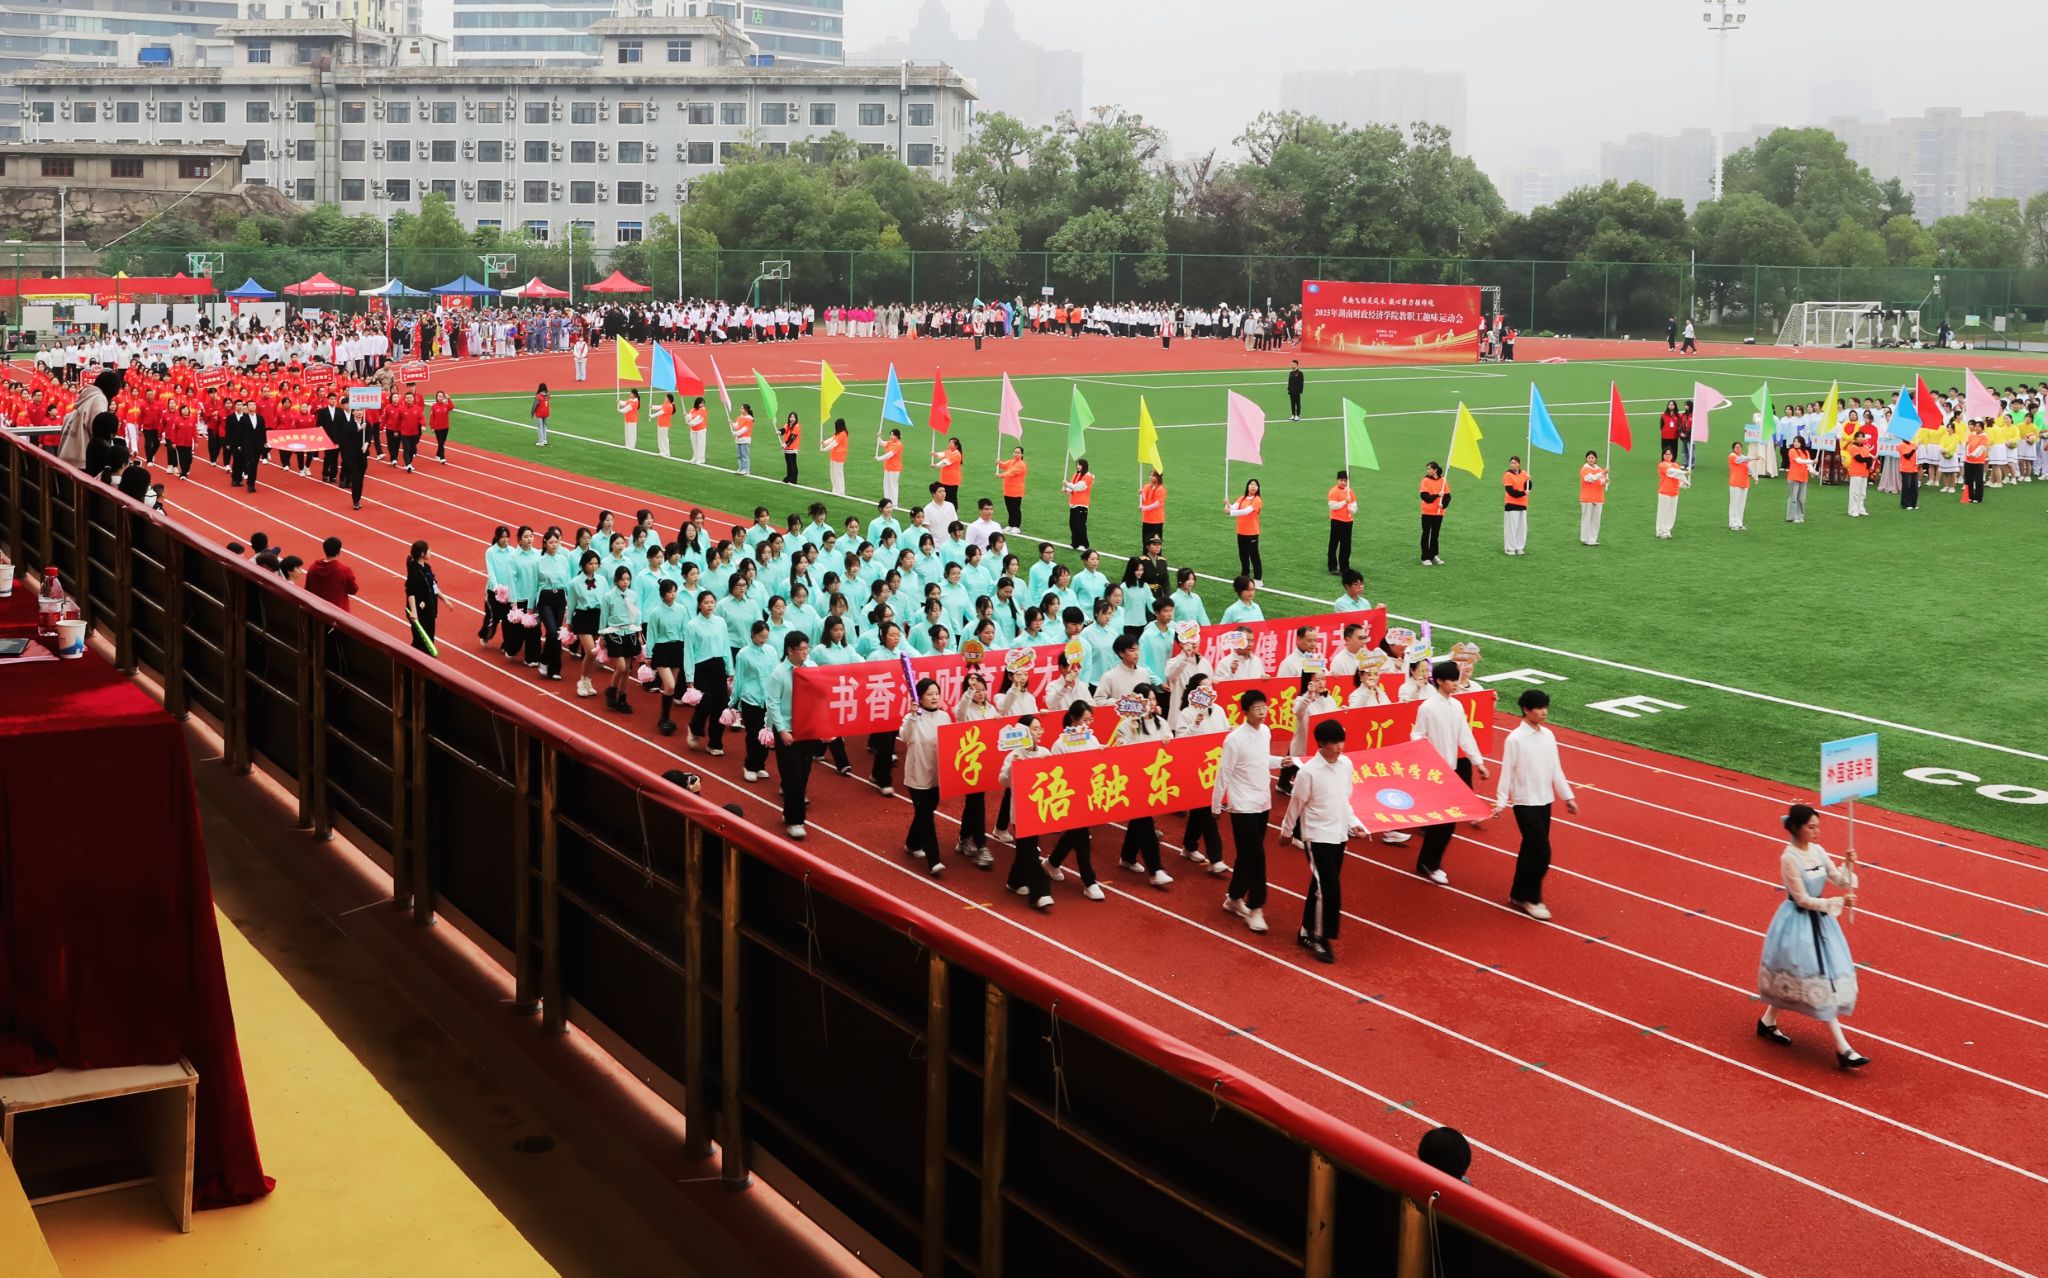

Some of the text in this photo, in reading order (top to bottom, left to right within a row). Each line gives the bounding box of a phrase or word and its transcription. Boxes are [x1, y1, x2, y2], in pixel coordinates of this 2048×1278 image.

[1315, 308, 1464, 324] 2025年湖南财政经济学院教职工趣味运动会
[1827, 757, 1873, 785] 外国语学院
